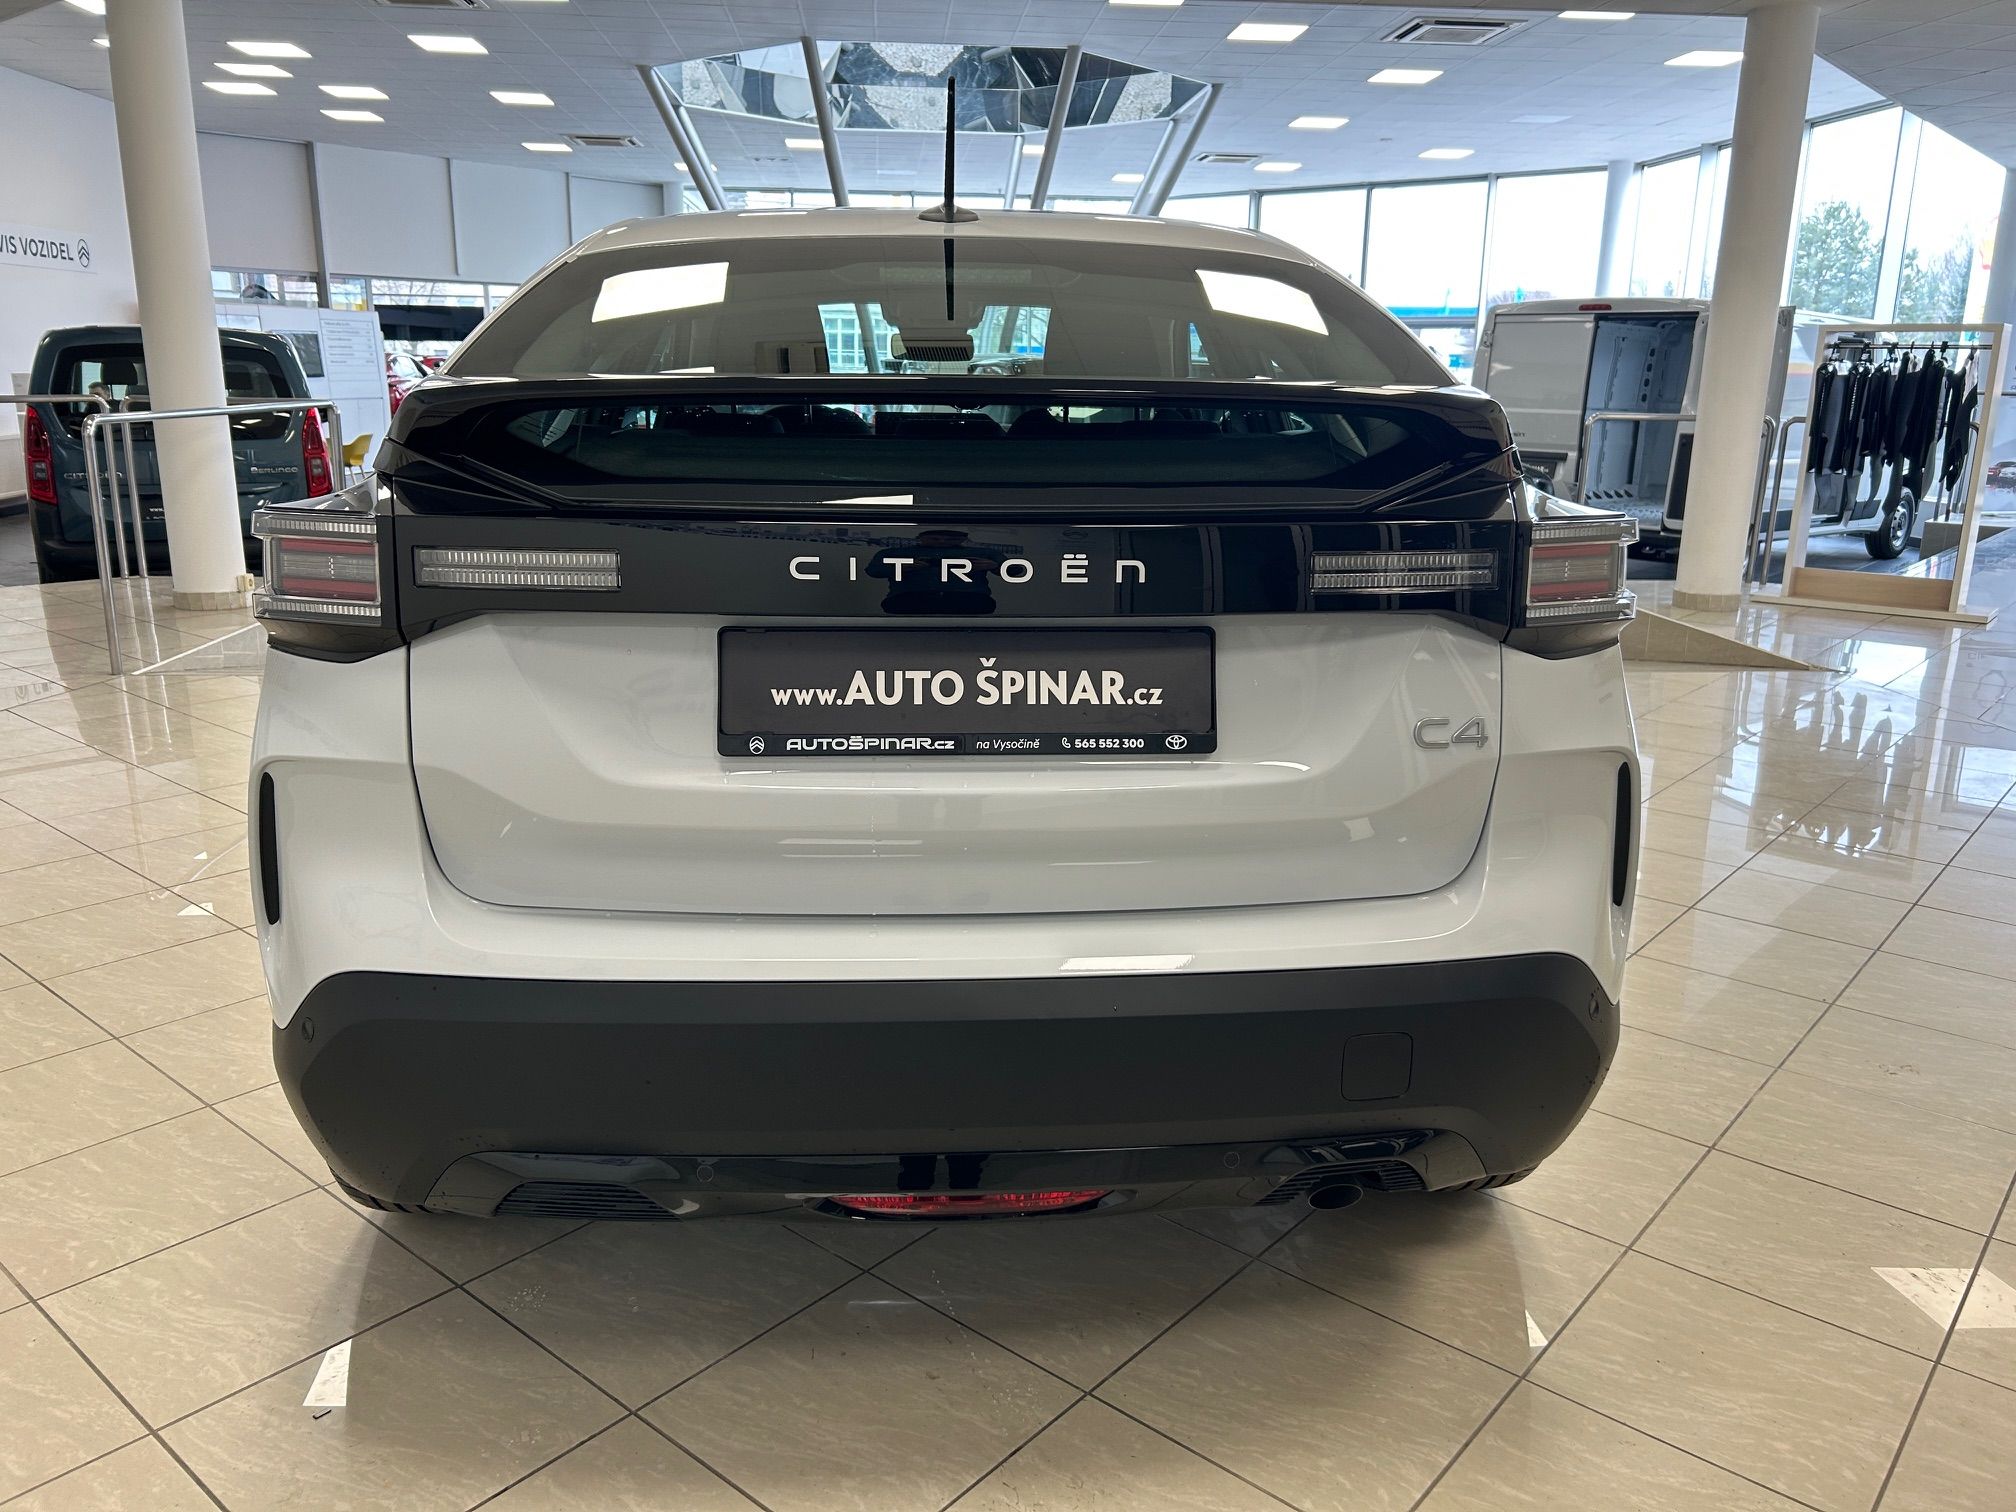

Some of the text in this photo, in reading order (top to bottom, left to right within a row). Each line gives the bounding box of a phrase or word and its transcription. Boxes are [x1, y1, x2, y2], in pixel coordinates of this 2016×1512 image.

[19, 236, 75, 262] VOZIDEL
[770, 657, 1164, 706] www.AUTO ŠPINAR.cz
[786, 735, 1145, 751] AUTOŠPINAR.cz na Vysočině 565 552 300
[1413, 716, 1489, 750] C4
